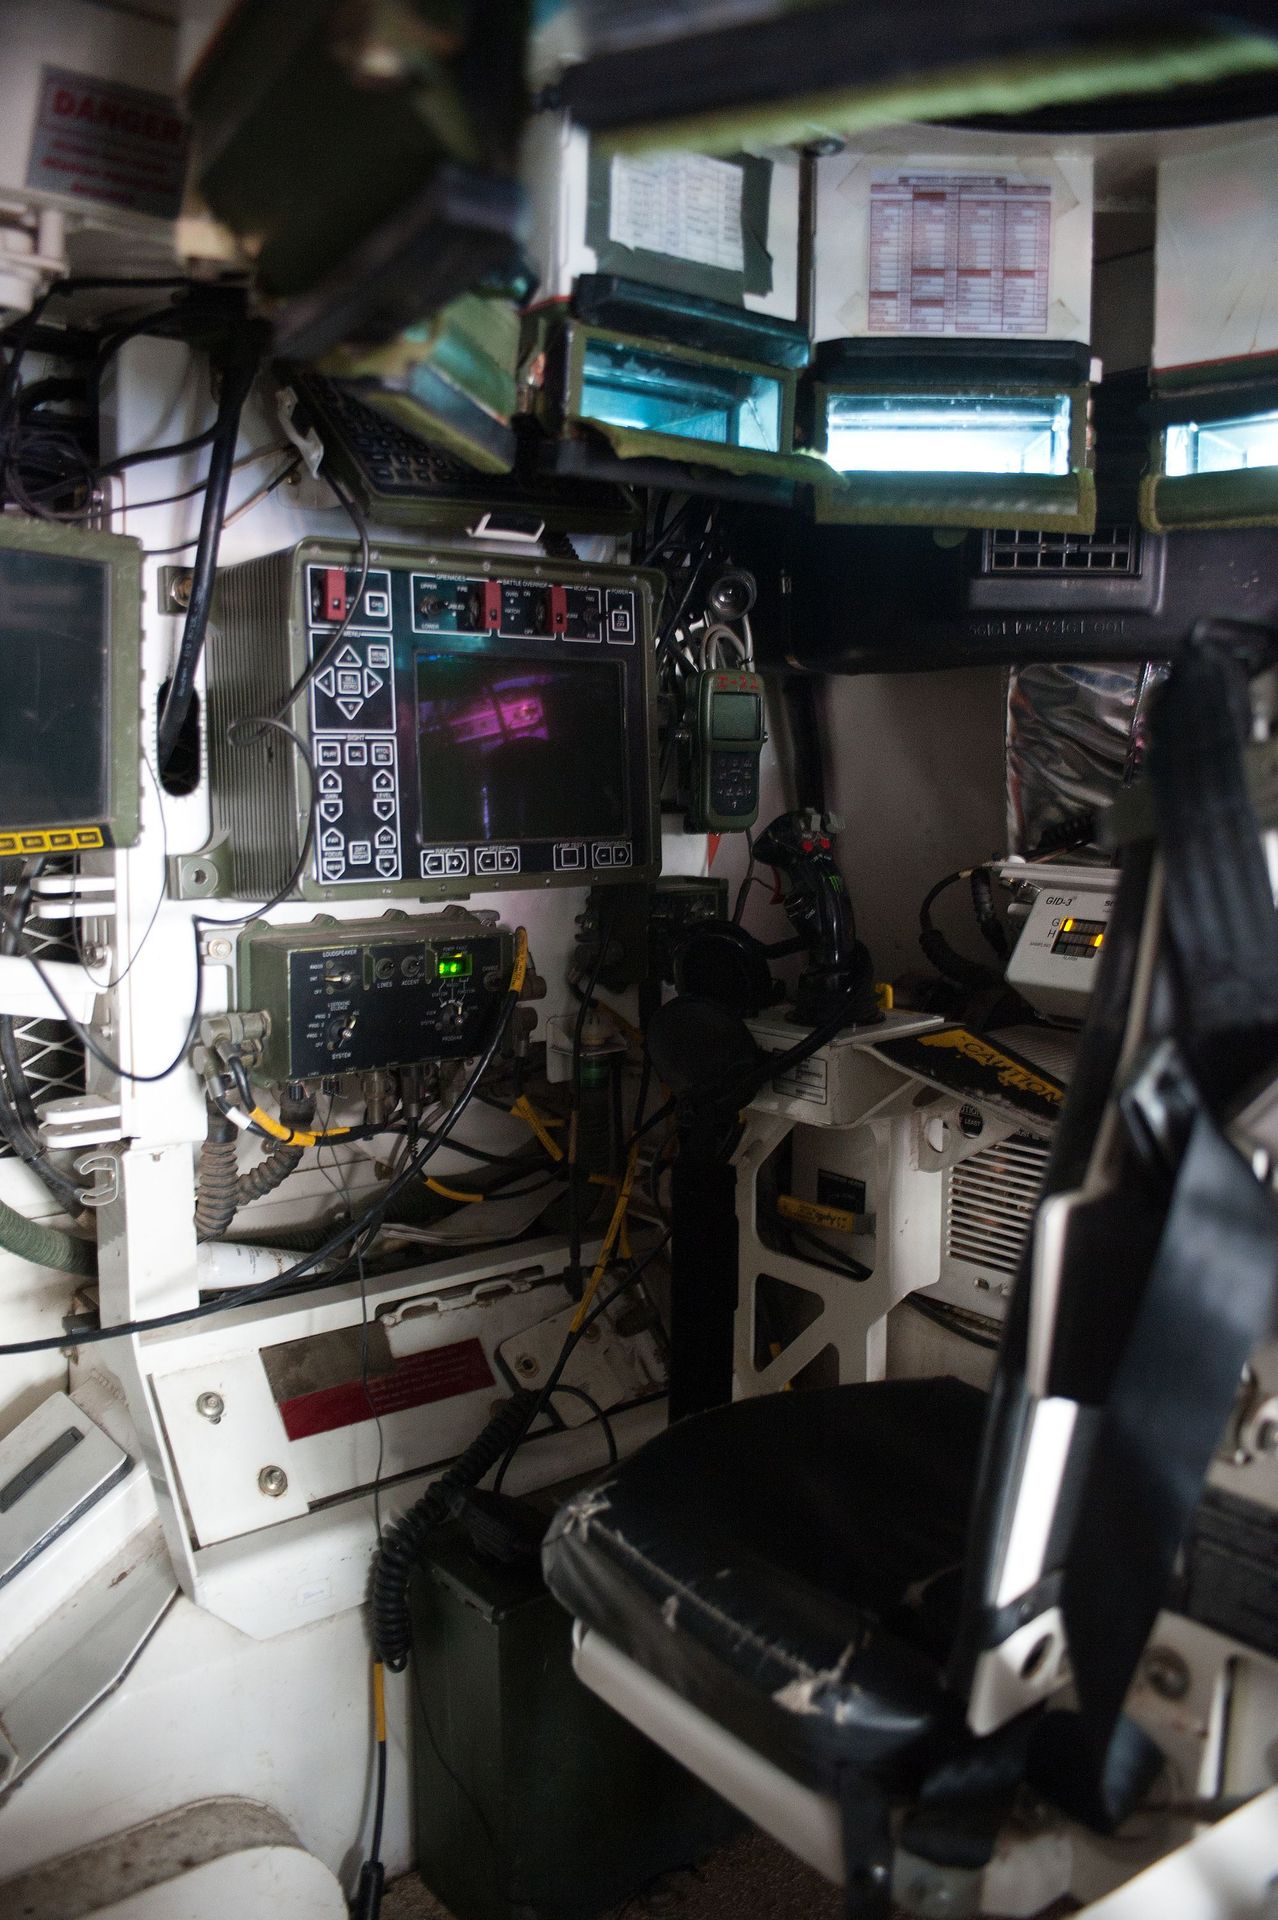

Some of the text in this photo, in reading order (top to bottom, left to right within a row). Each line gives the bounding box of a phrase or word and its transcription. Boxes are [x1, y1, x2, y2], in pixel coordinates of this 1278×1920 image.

[436, 574, 467, 582] GRENADES
[1051, 918, 1060, 927] G
[1047, 929, 1056, 938] H
[323, 949, 358, 957] LOUDSPEAKER
[332, 1051, 352, 1060] SYSTEM
